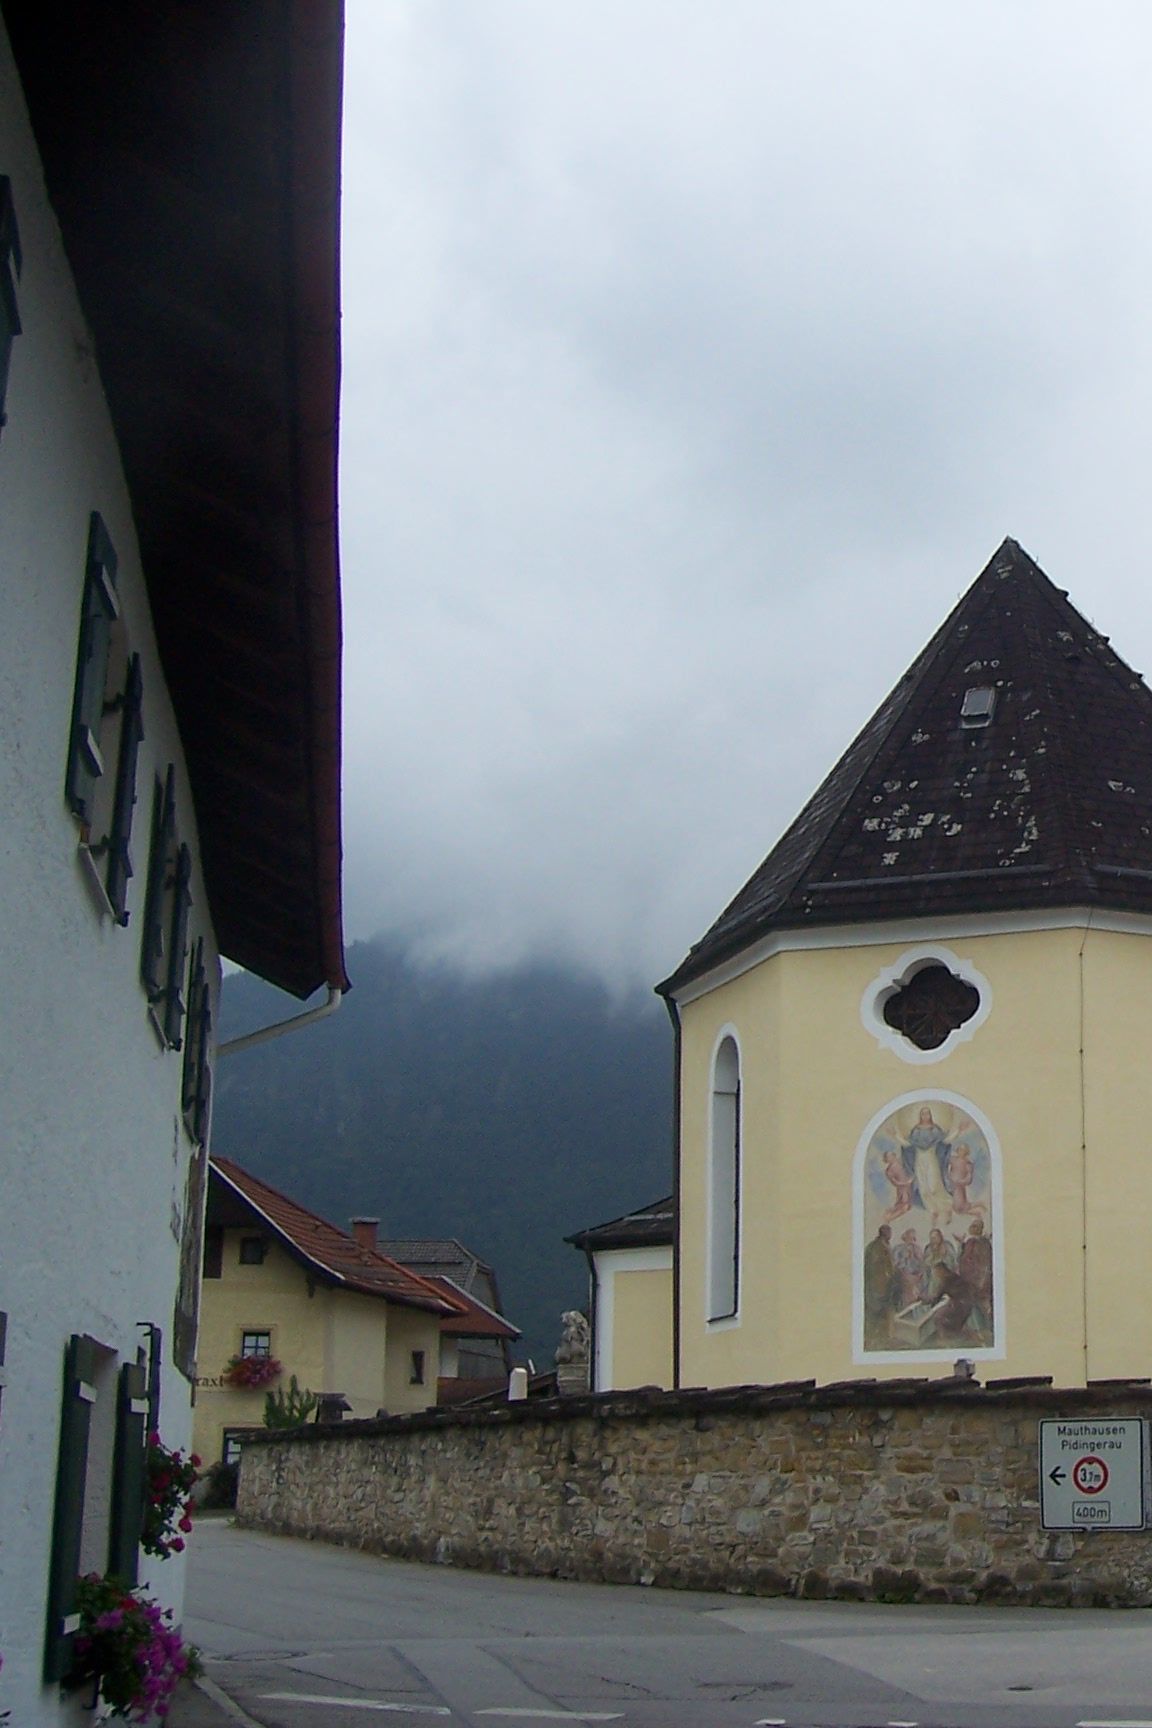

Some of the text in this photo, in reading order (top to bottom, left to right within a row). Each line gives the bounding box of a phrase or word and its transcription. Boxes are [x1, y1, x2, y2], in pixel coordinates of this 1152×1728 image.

[1057, 1425, 1126, 1436] Mauthausen
[1061, 1440, 1122, 1452] Pidingerau
[1075, 1507, 1108, 1518] 400m
